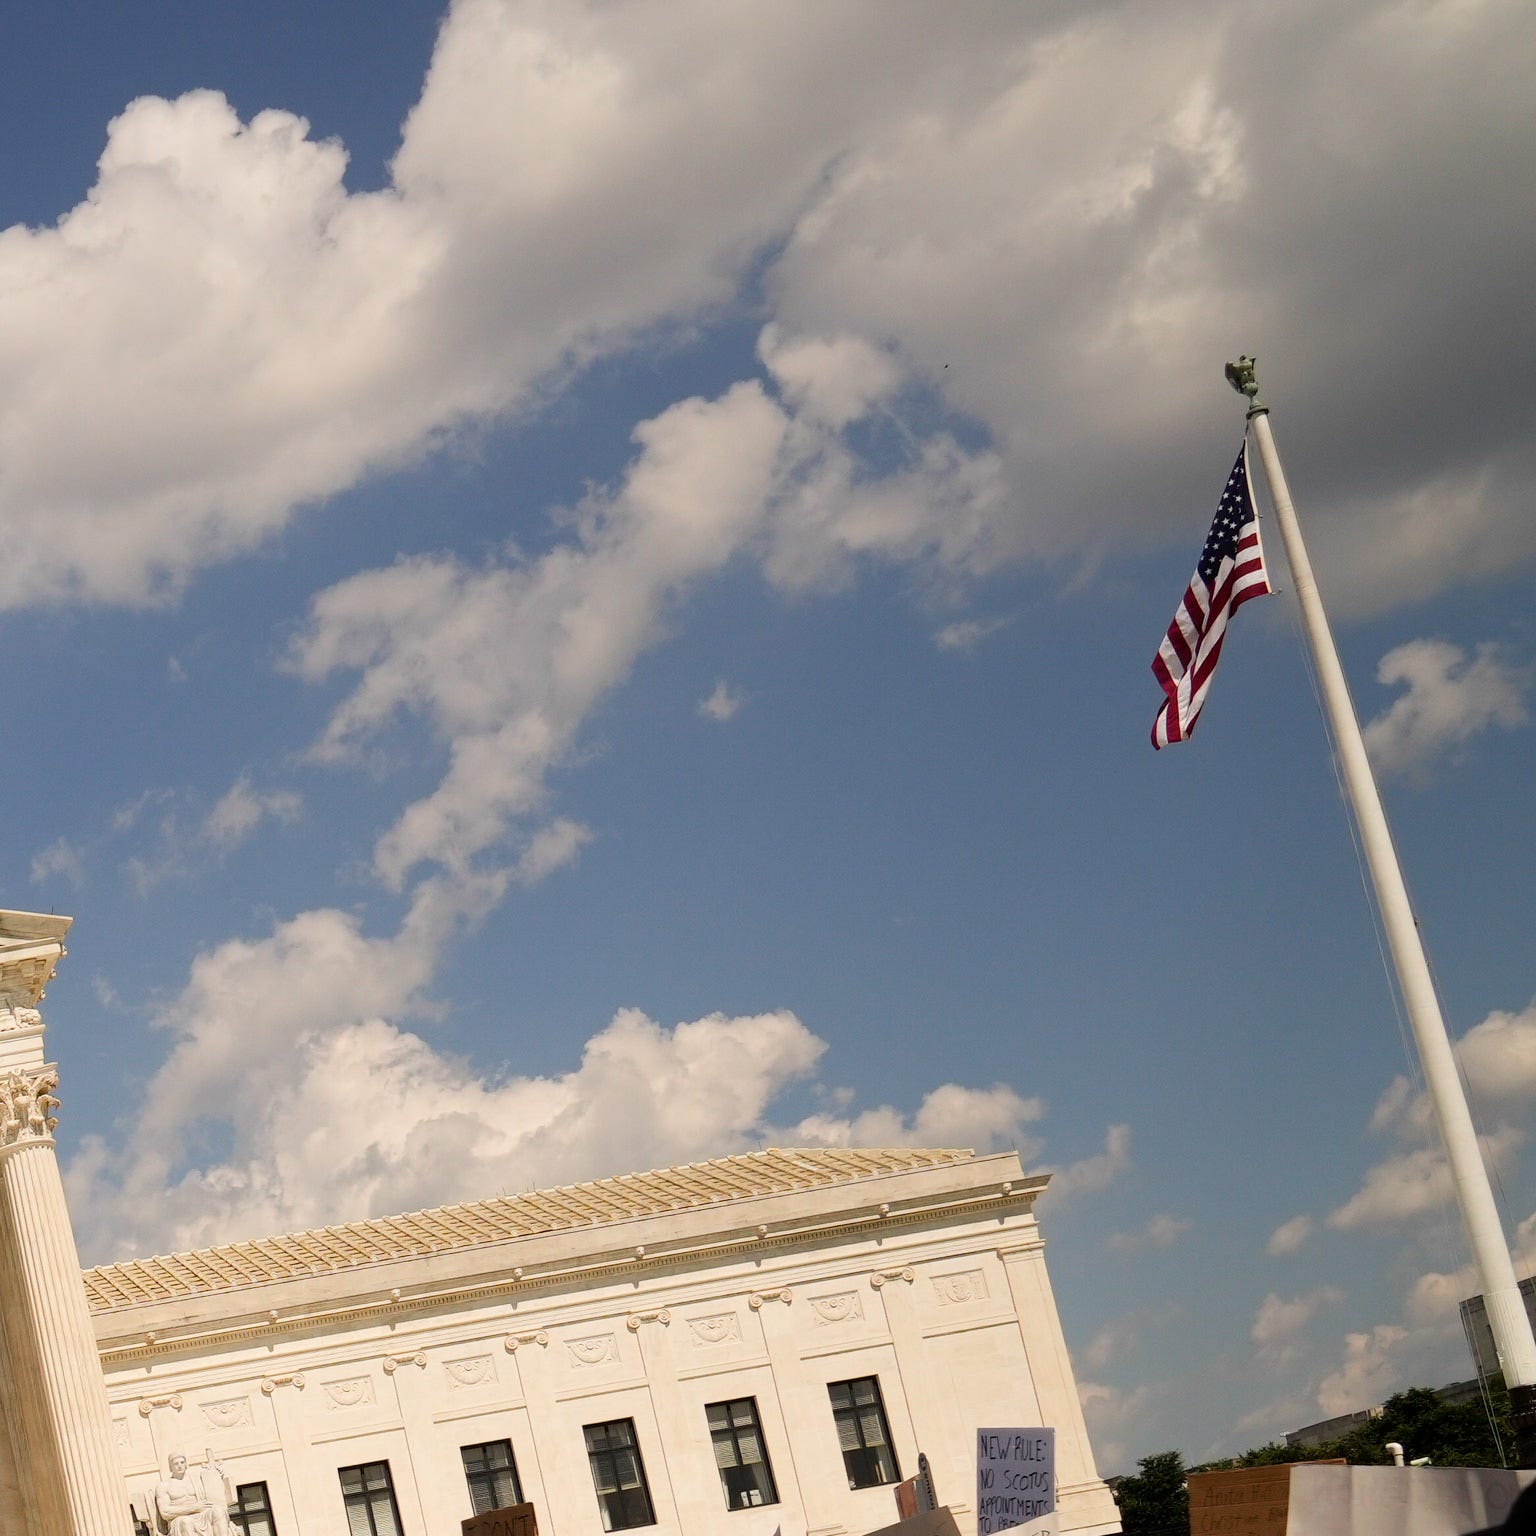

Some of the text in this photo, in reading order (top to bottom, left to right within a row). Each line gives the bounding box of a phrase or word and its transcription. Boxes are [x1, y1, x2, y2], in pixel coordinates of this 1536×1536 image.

[981, 1435, 1047, 1462] NEW RULE:
[980, 1468, 1049, 1493] NO SCOTUS
[979, 1495, 1049, 1517] APPOINTMENTS
[979, 1516, 991, 1534] TO
